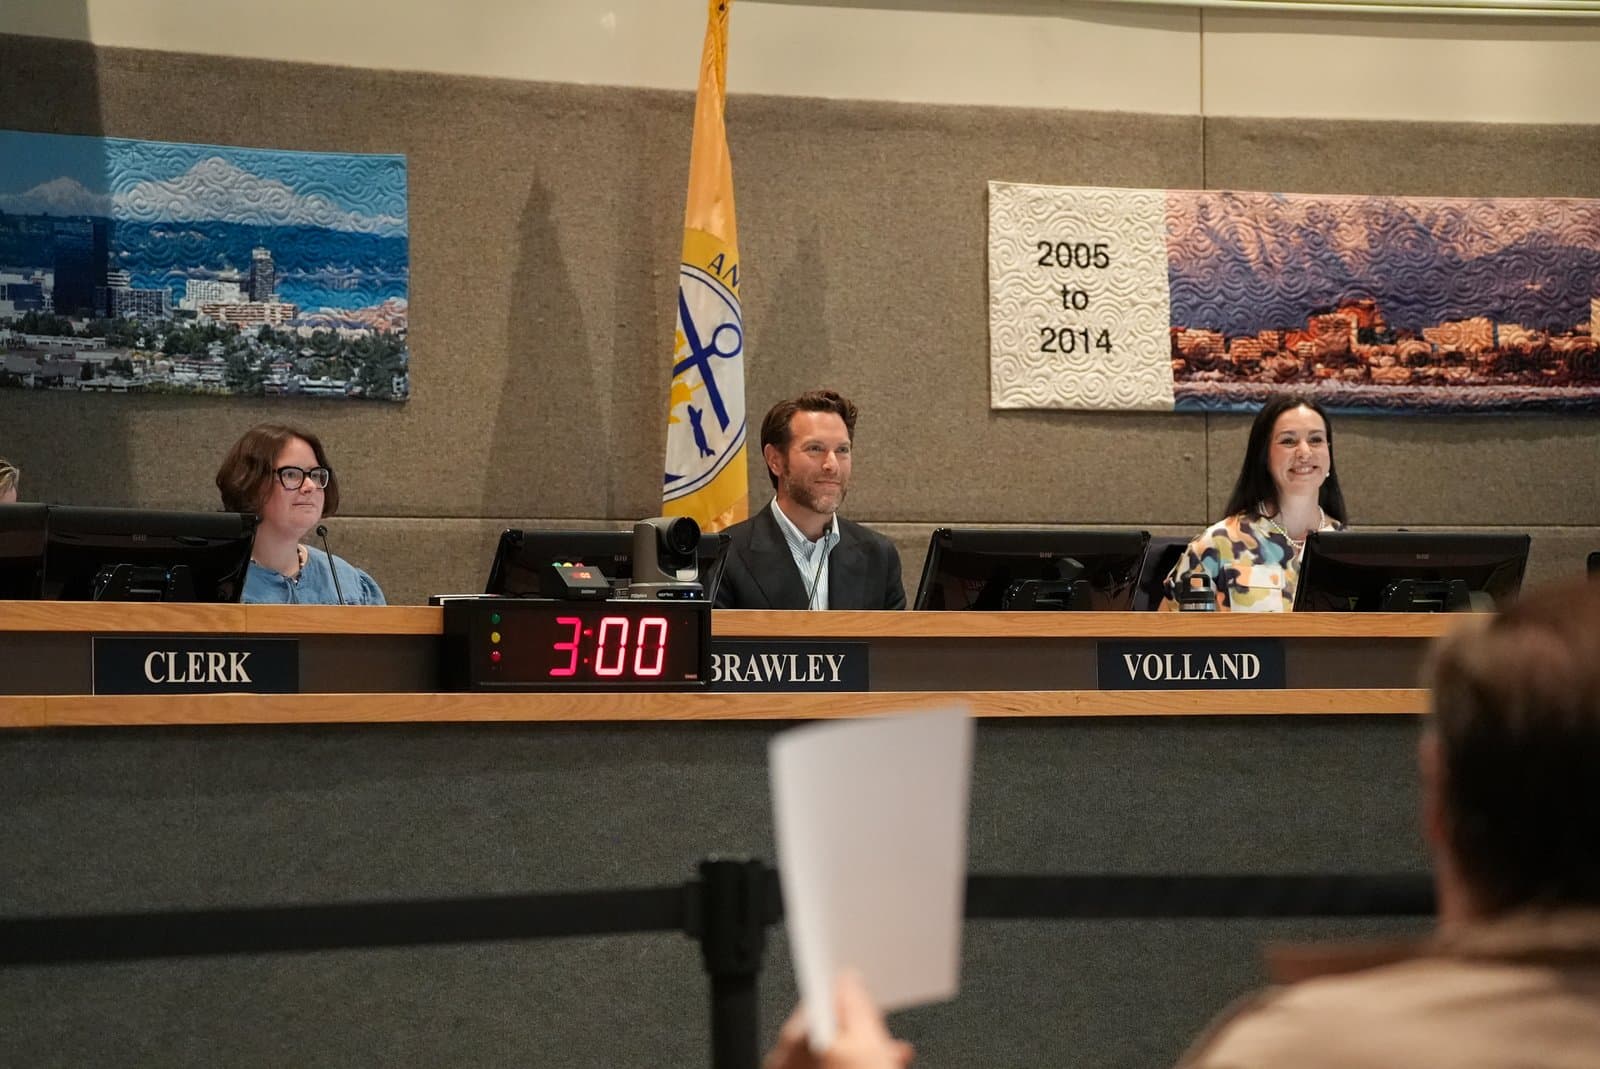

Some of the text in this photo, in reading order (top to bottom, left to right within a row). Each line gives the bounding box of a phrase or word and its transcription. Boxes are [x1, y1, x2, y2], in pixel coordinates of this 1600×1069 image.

[1037, 241, 1110, 269] 2005
[1060, 284, 1089, 311] to
[1040, 327, 1113, 354] 2014
[549, 616, 668, 676] 3:00
[144, 650, 252, 683] CLERK
[710, 653, 846, 682] BRAWLEY
[1122, 653, 1261, 681] VOLLAND
